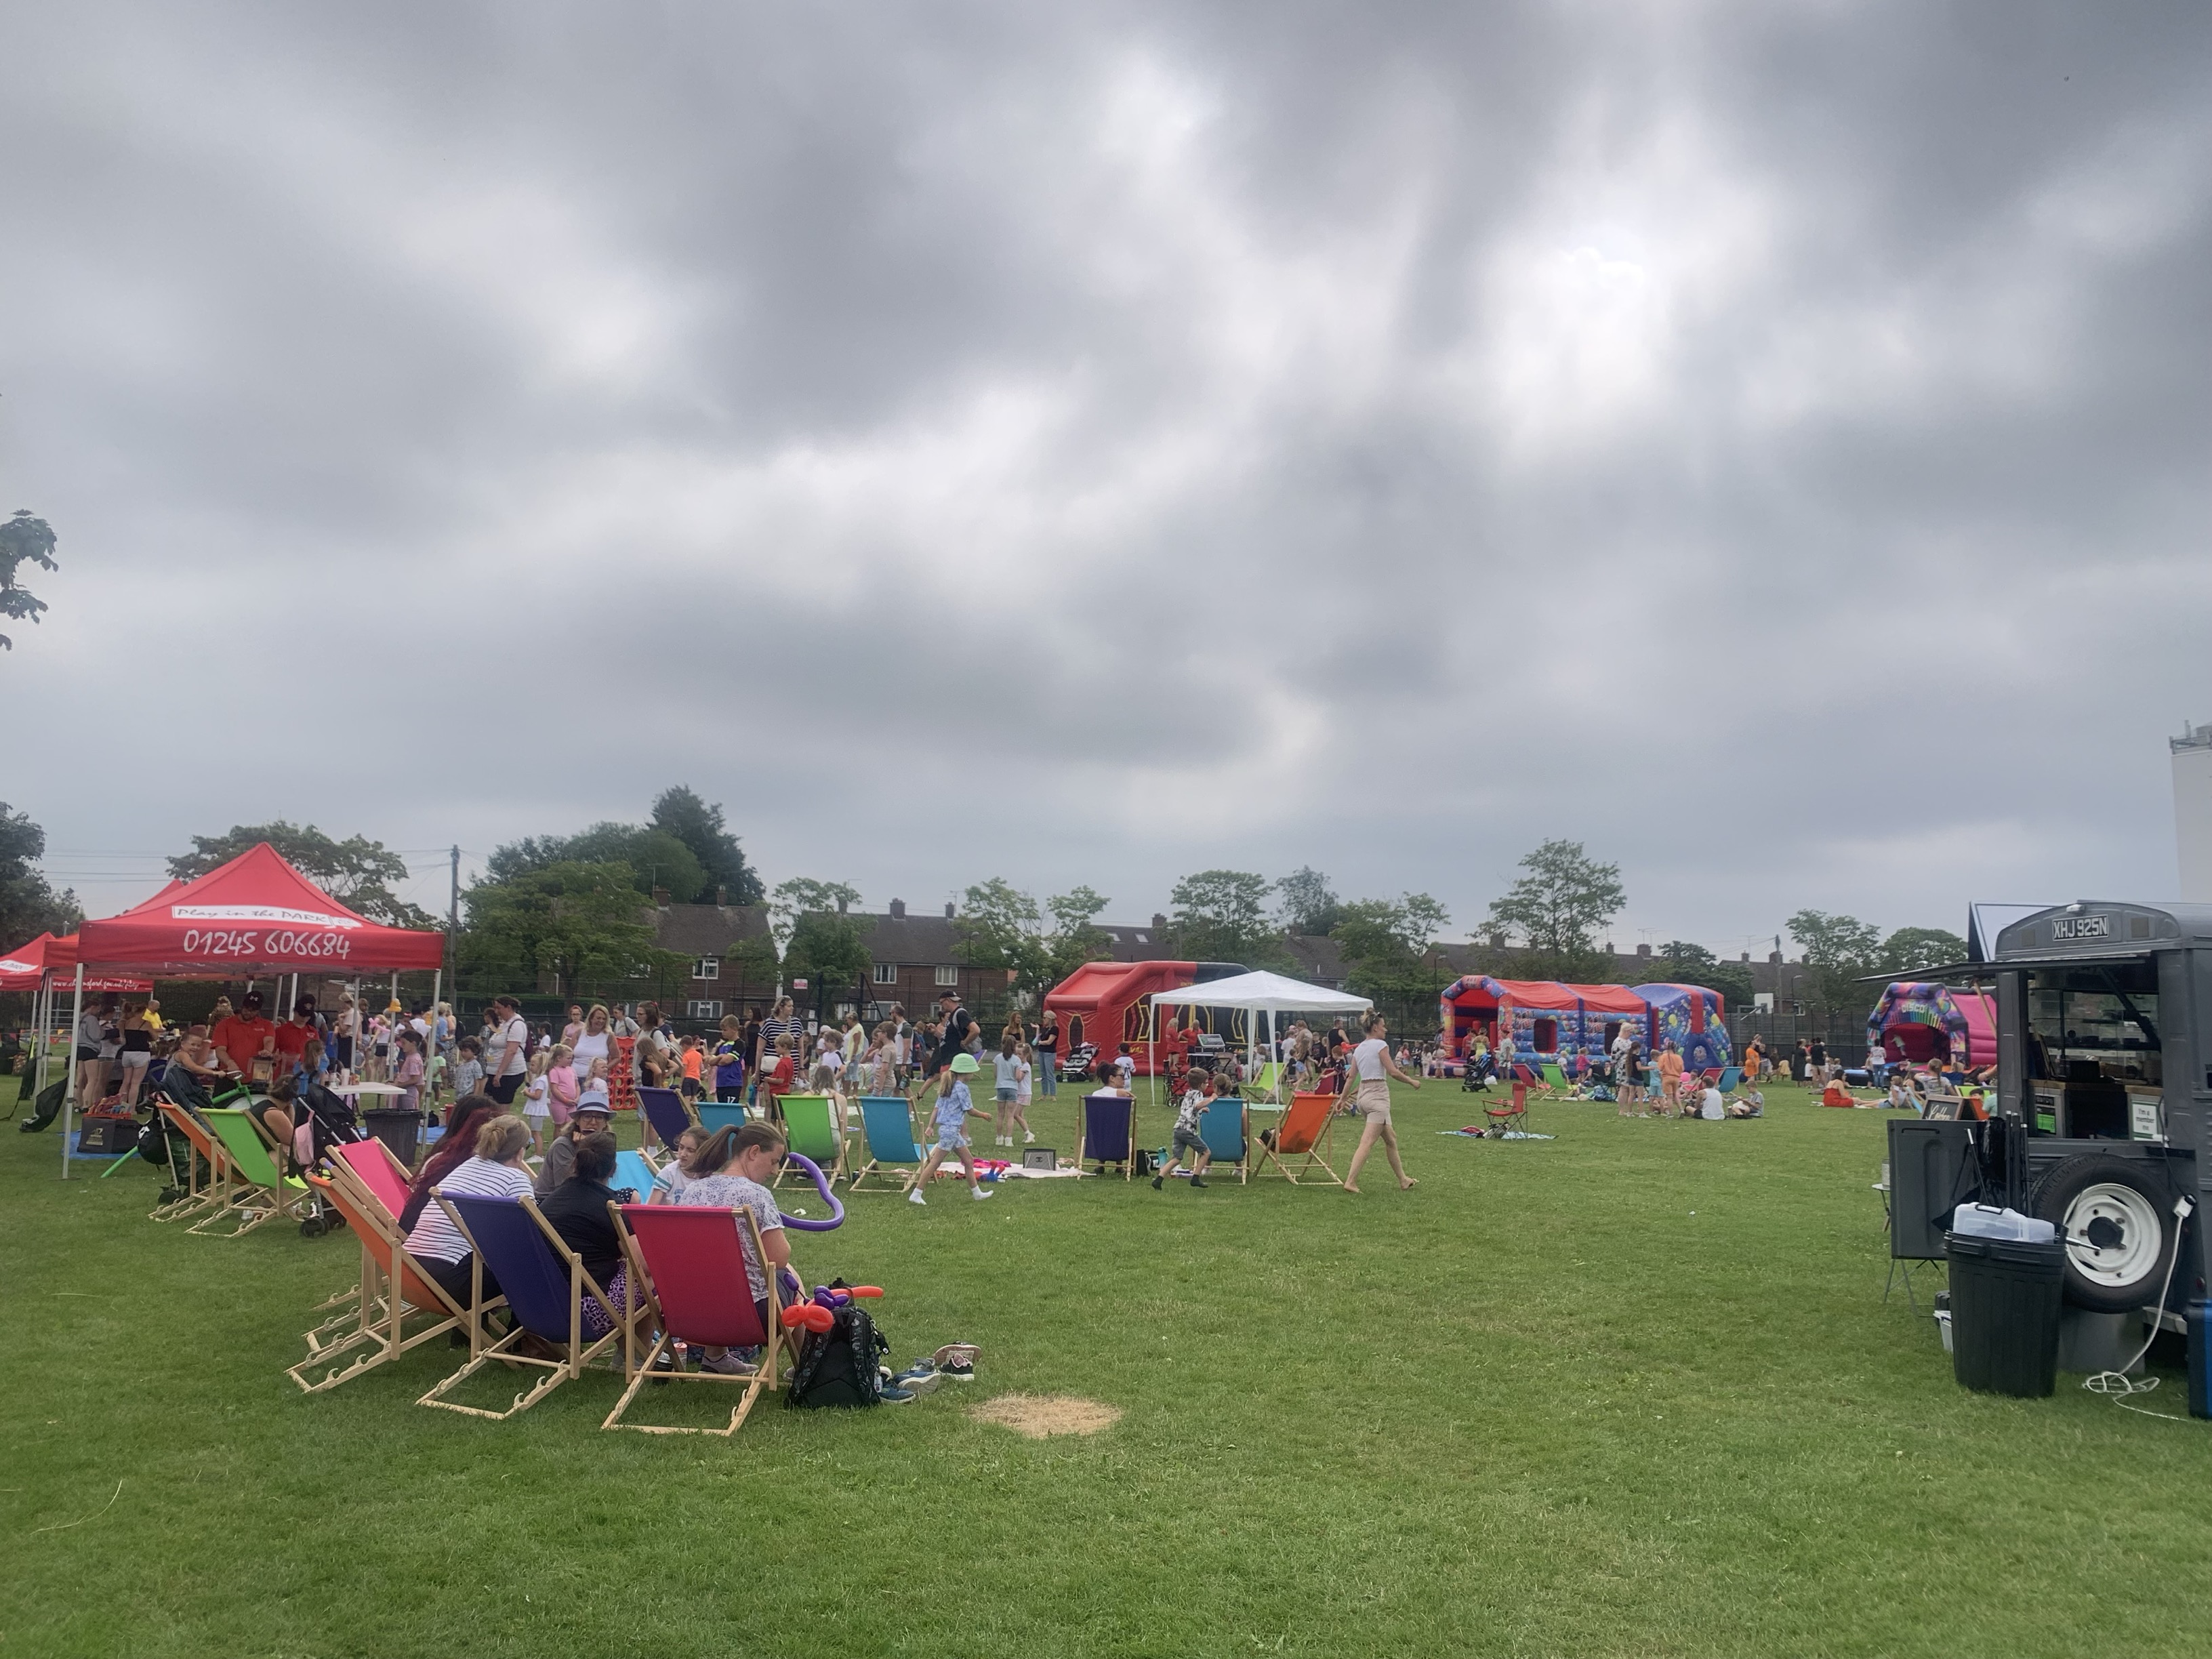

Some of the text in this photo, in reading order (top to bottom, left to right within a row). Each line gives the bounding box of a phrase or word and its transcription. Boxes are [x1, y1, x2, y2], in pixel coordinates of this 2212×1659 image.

[178, 908, 218, 918] Play
[282, 911, 328, 922] PARK
[2053, 917, 2107, 938] XHJ 925N
[184, 929, 351, 960] 01245 606684
[1902, 1002, 1925, 1013] DISCO
[726, 1095, 737, 1104] 17
